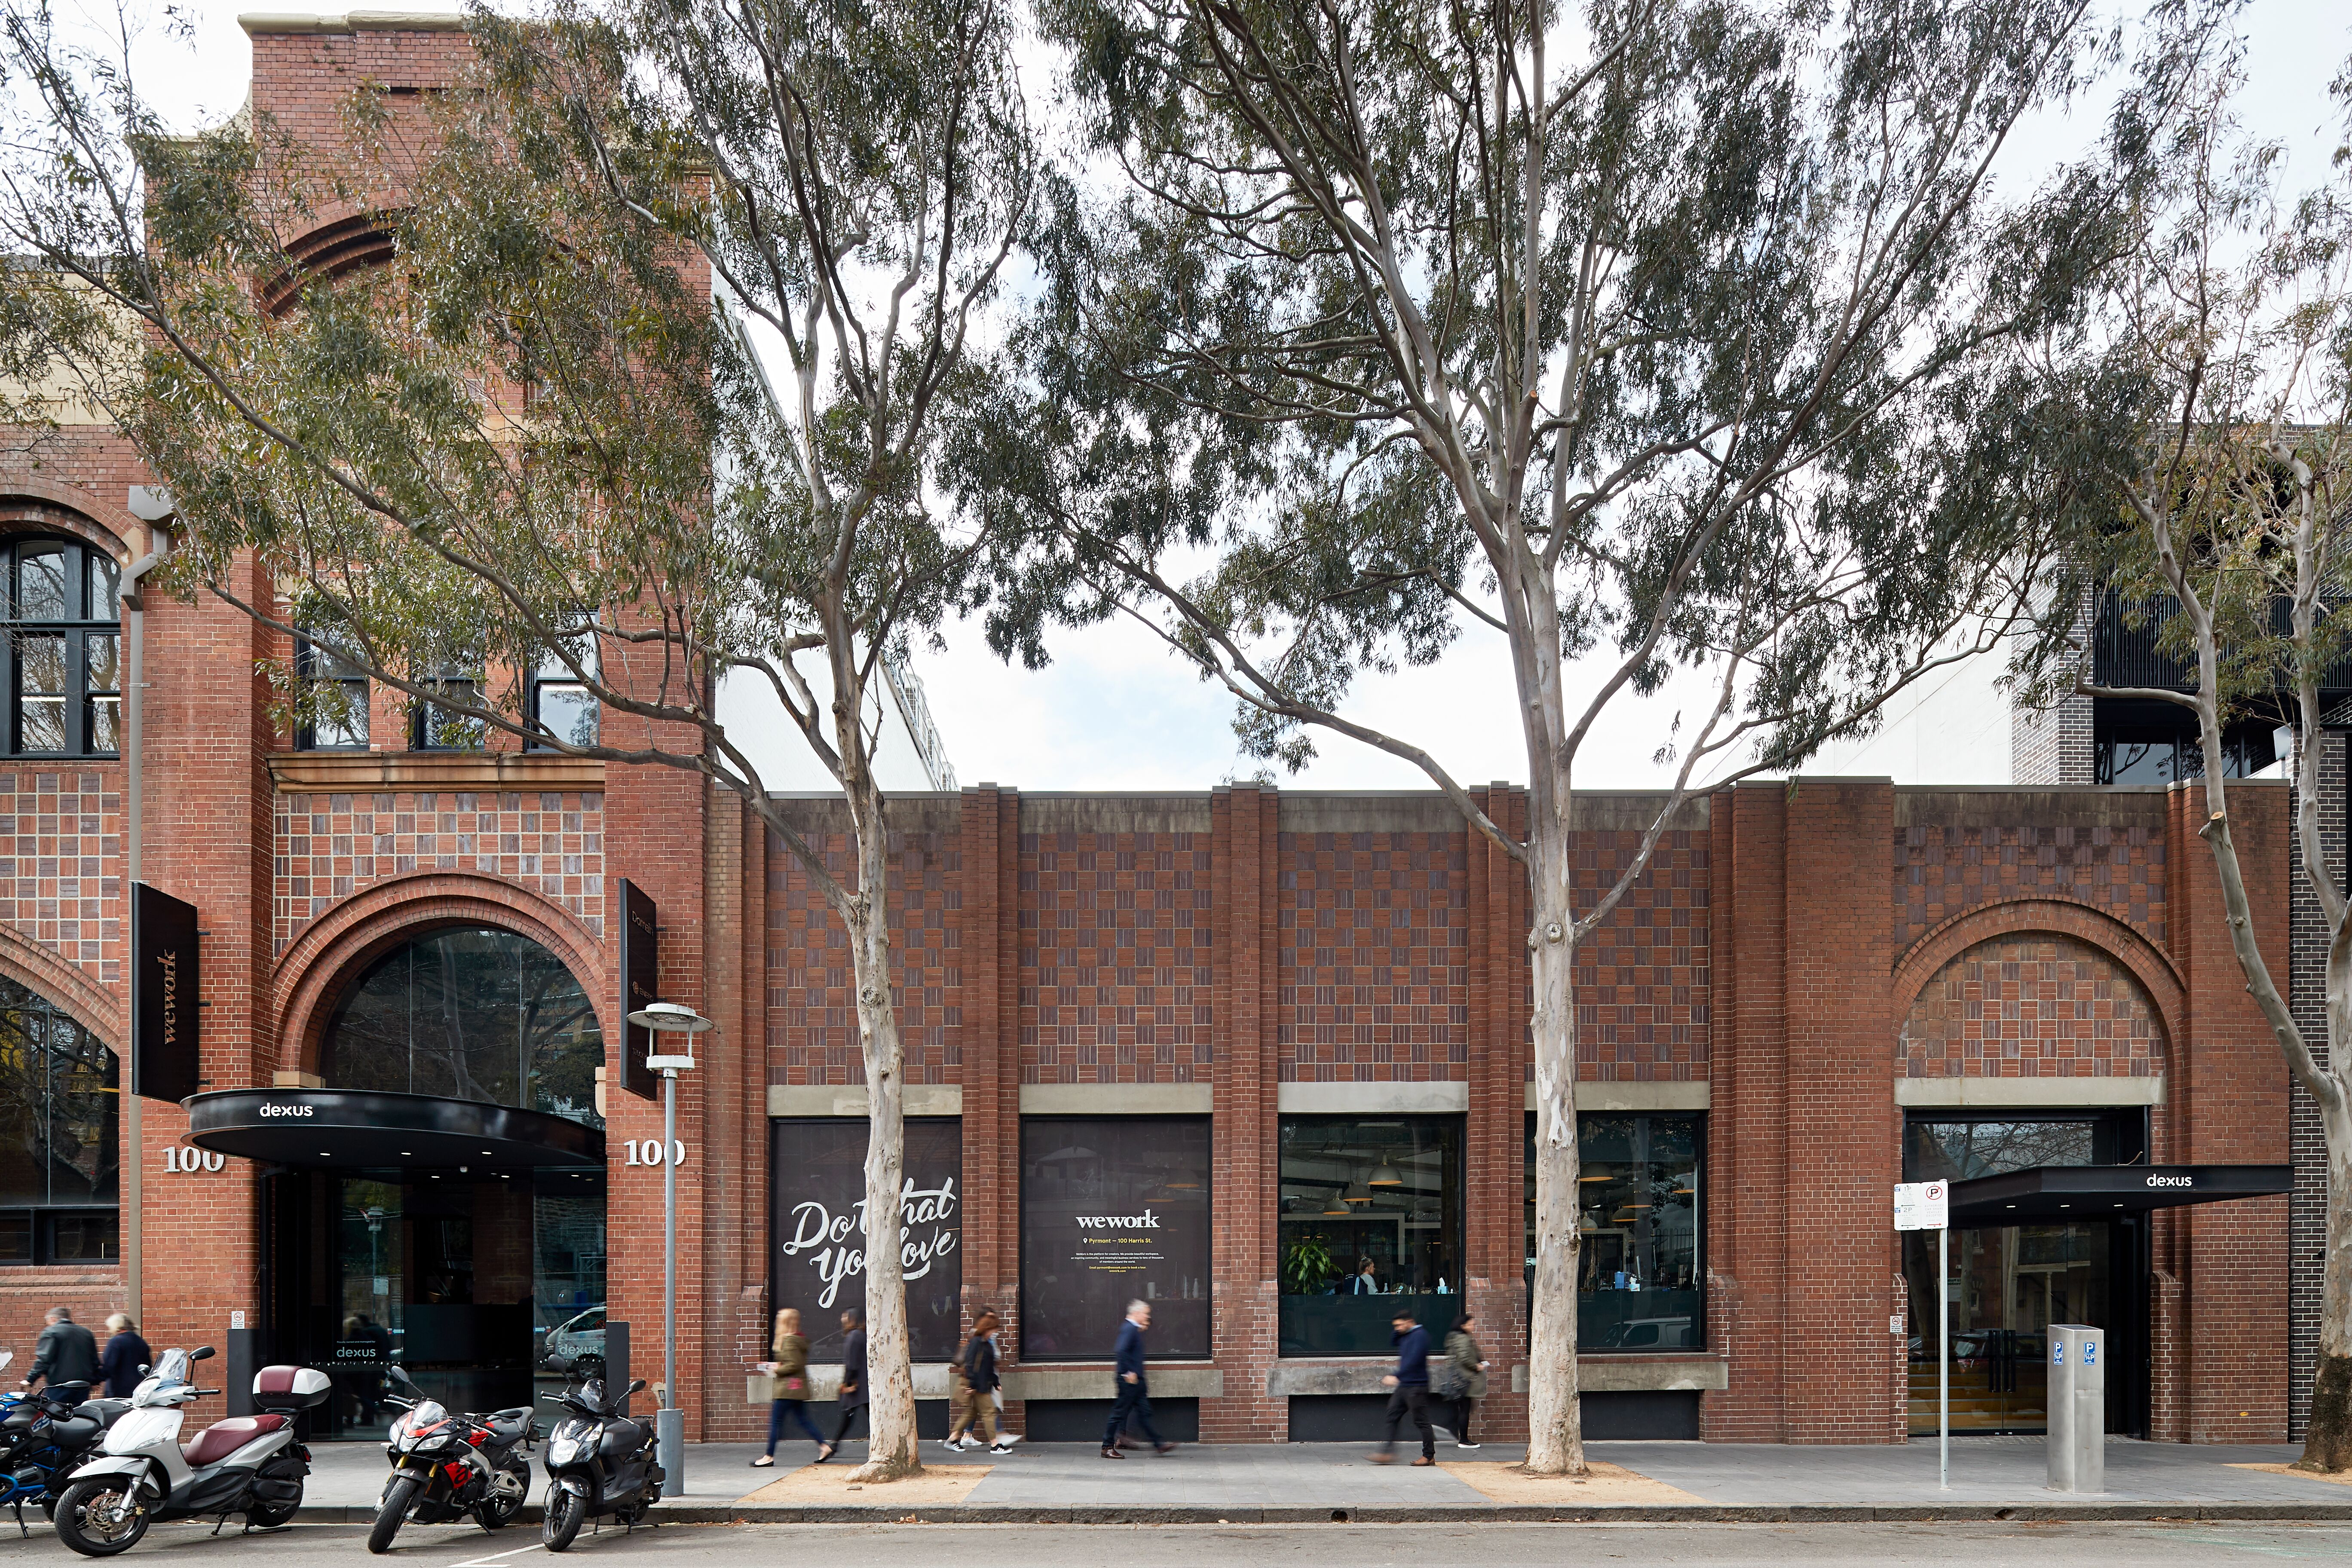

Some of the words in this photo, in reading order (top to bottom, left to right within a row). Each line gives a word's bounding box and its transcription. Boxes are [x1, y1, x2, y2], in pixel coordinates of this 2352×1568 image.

[632, 910, 653, 937] Domain
[157, 949, 176, 1045] wework
[259, 1102, 313, 1117] dexus
[162, 1146, 224, 1173] 100
[2147, 1173, 2192, 1187] dexus
[783, 1201, 856, 1255] Do
[852, 1177, 956, 1235] hat
[1075, 1209, 1161, 1228] wework
[337, 1347, 376, 1357] dexus
[559, 1344, 599, 1354] dexus
[2055, 1343, 2061, 1352] P
[2086, 1343, 2094, 1353] P
